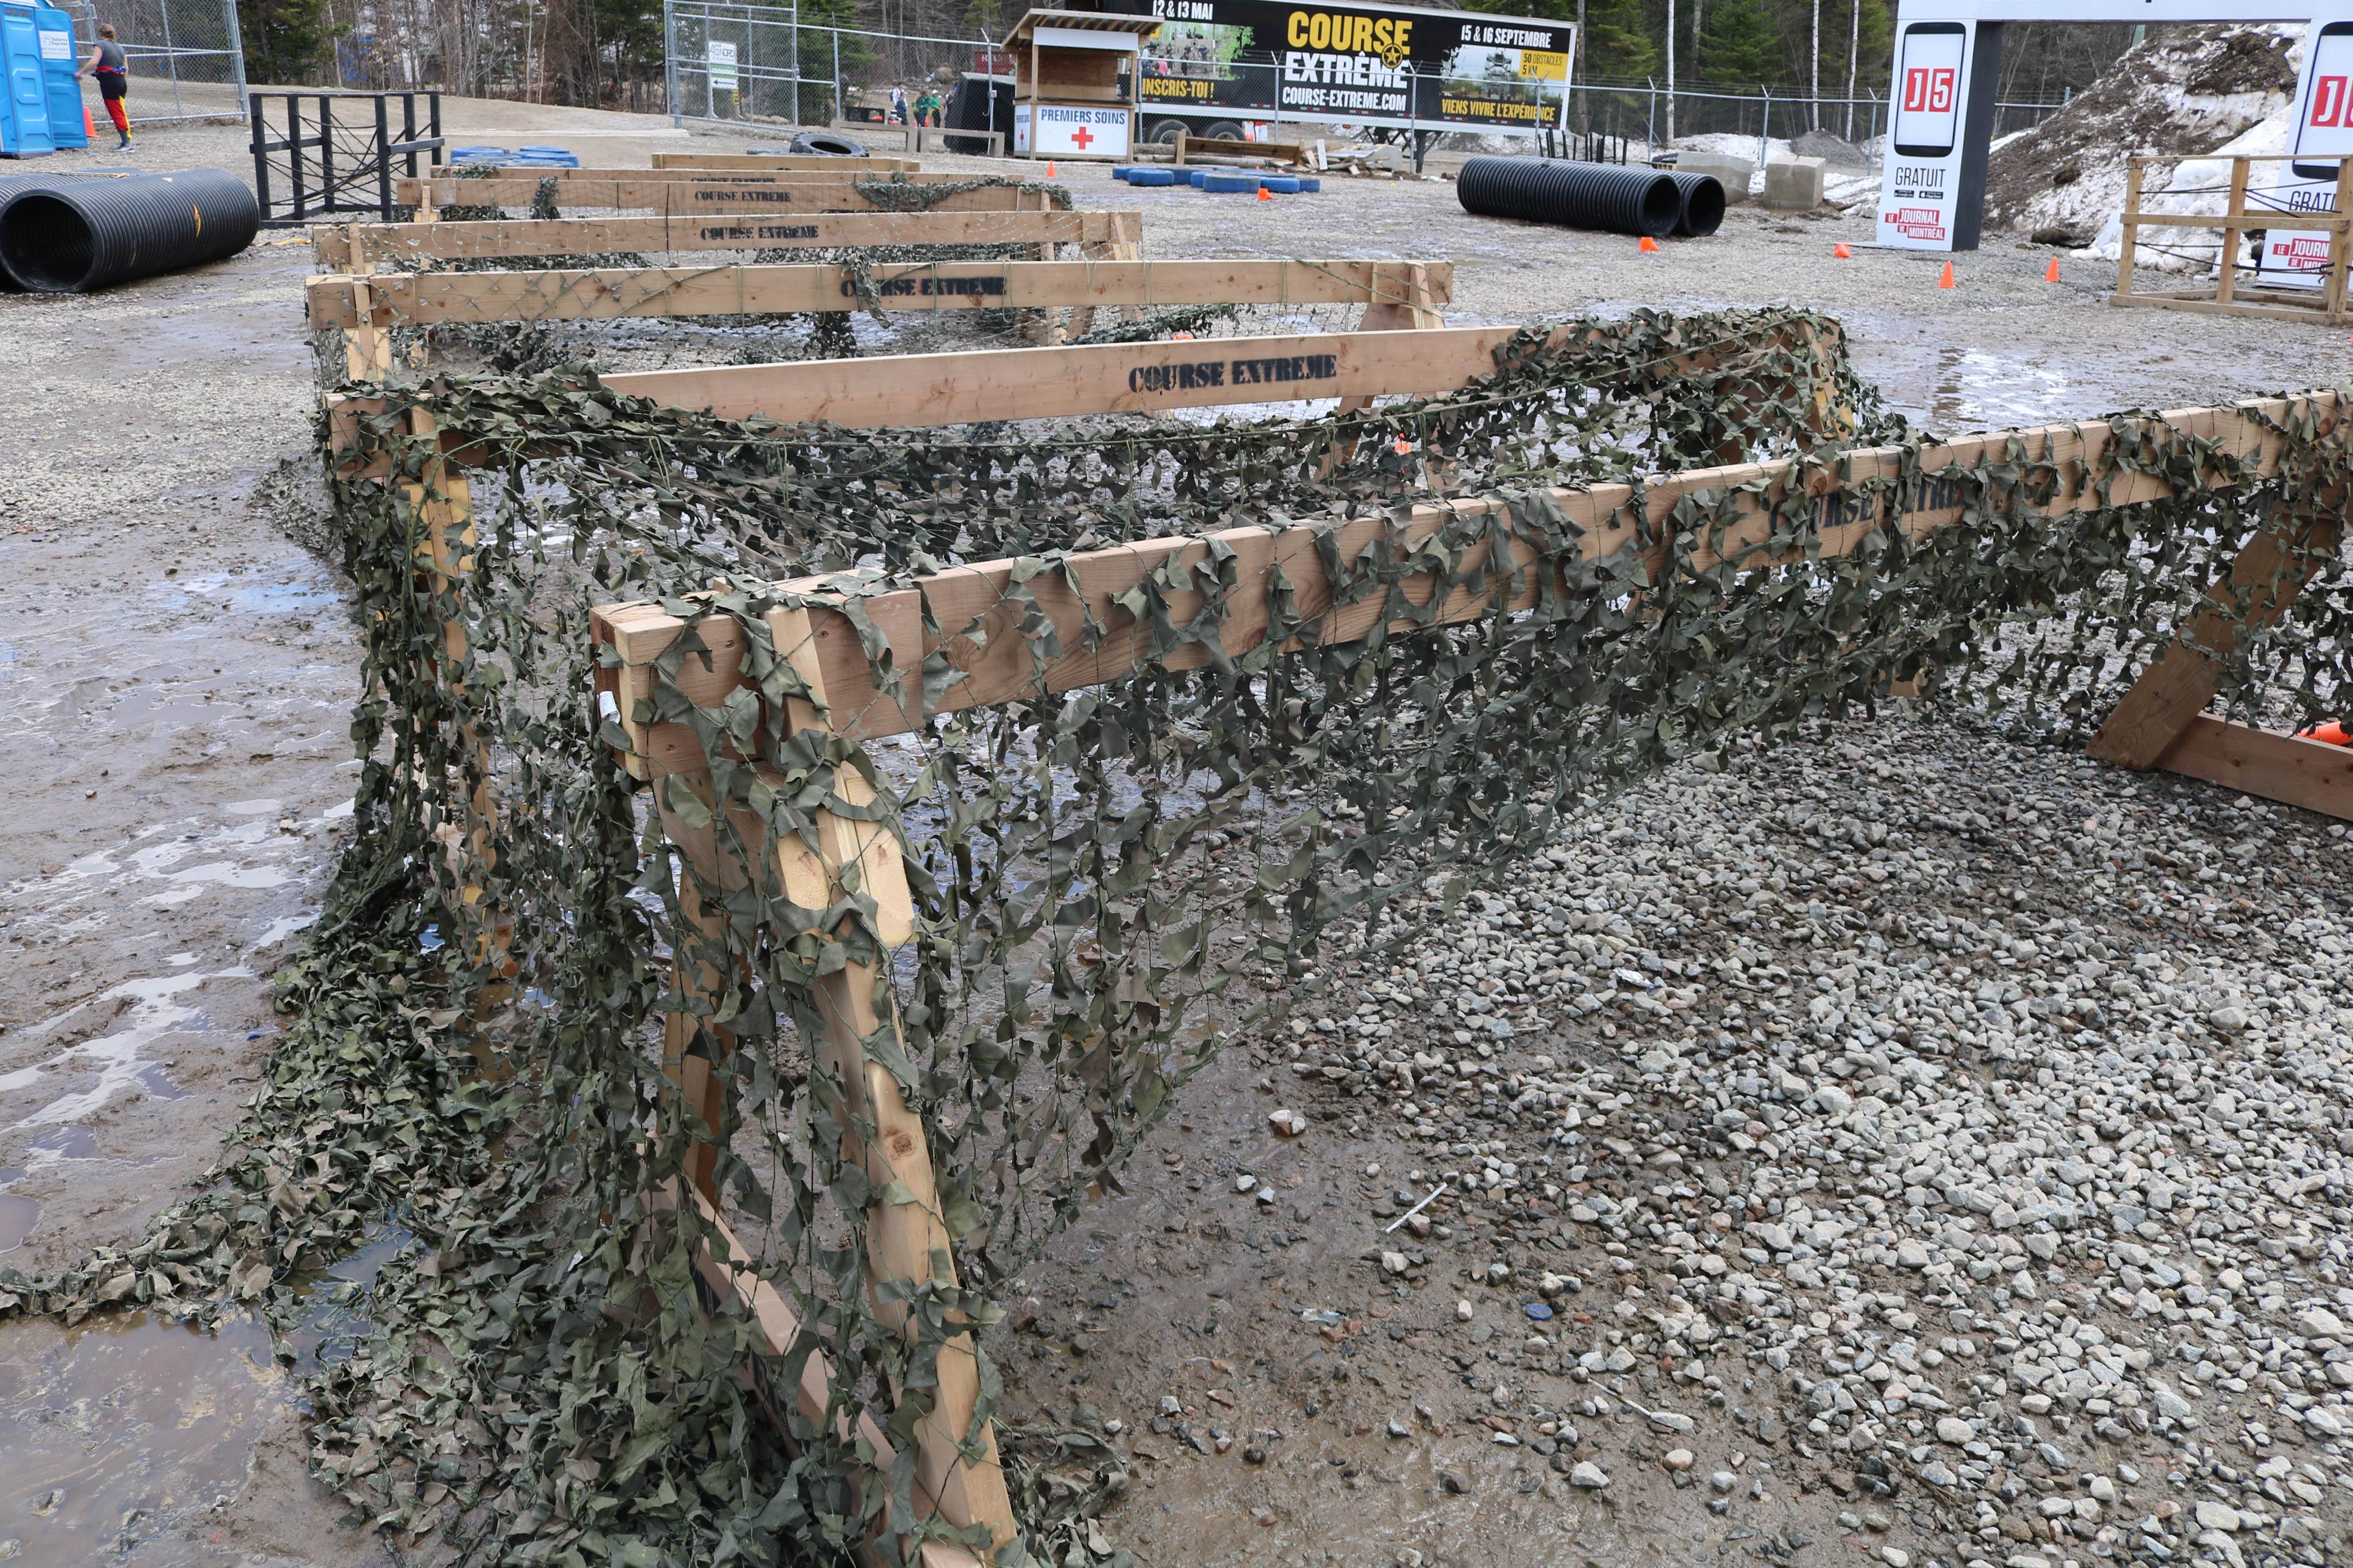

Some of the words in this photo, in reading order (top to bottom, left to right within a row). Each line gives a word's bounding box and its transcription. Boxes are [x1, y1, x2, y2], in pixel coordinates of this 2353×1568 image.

[1152, 0, 1165, 17] 12
[1166, 2, 1175, 18] &
[1178, 1, 1190, 19] 13
[1191, 2, 1214, 20] MAI
[1287, 10, 1413, 56] COURSE
[1460, 25, 1472, 41] 15
[1473, 25, 1481, 42] &
[1483, 27, 1494, 44] 16
[1494, 28, 1552, 48] SEPTEMBRE
[1523, 53, 1532, 63] 50
[1532, 55, 1563, 67] OBSTACLES
[1284, 50, 1410, 89] EXTRÊME
[1522, 64, 1527, 75] 5
[1527, 65, 1538, 76] KM
[1282, 86, 1407, 112] COURSE-EXTREME.COM
[1441, 98, 1468, 115] VIENS
[1470, 101, 1495, 117] VIVRE
[1040, 109, 1091, 123] PREMIERS
[1094, 111, 1125, 125] SOINS
[1895, 167, 1946, 188] GRATUIT
[695, 191, 738, 201] COURSE
[741, 191, 791, 202] EXTREME
[1888, 214, 1895, 222] LE
[1899, 209, 1938, 225] JOURNAL
[700, 227, 754, 240] COURSE
[758, 225, 819, 239] EXTREME
[1908, 226, 1944, 240] MONTRÉAL
[2277, 245, 2285, 254] LE
[2291, 258, 2298, 267] DE
[921, 276, 1006, 296] EXTREME
[1129, 361, 1224, 393] COURSE
[1232, 354, 1337, 385] EXTREME
